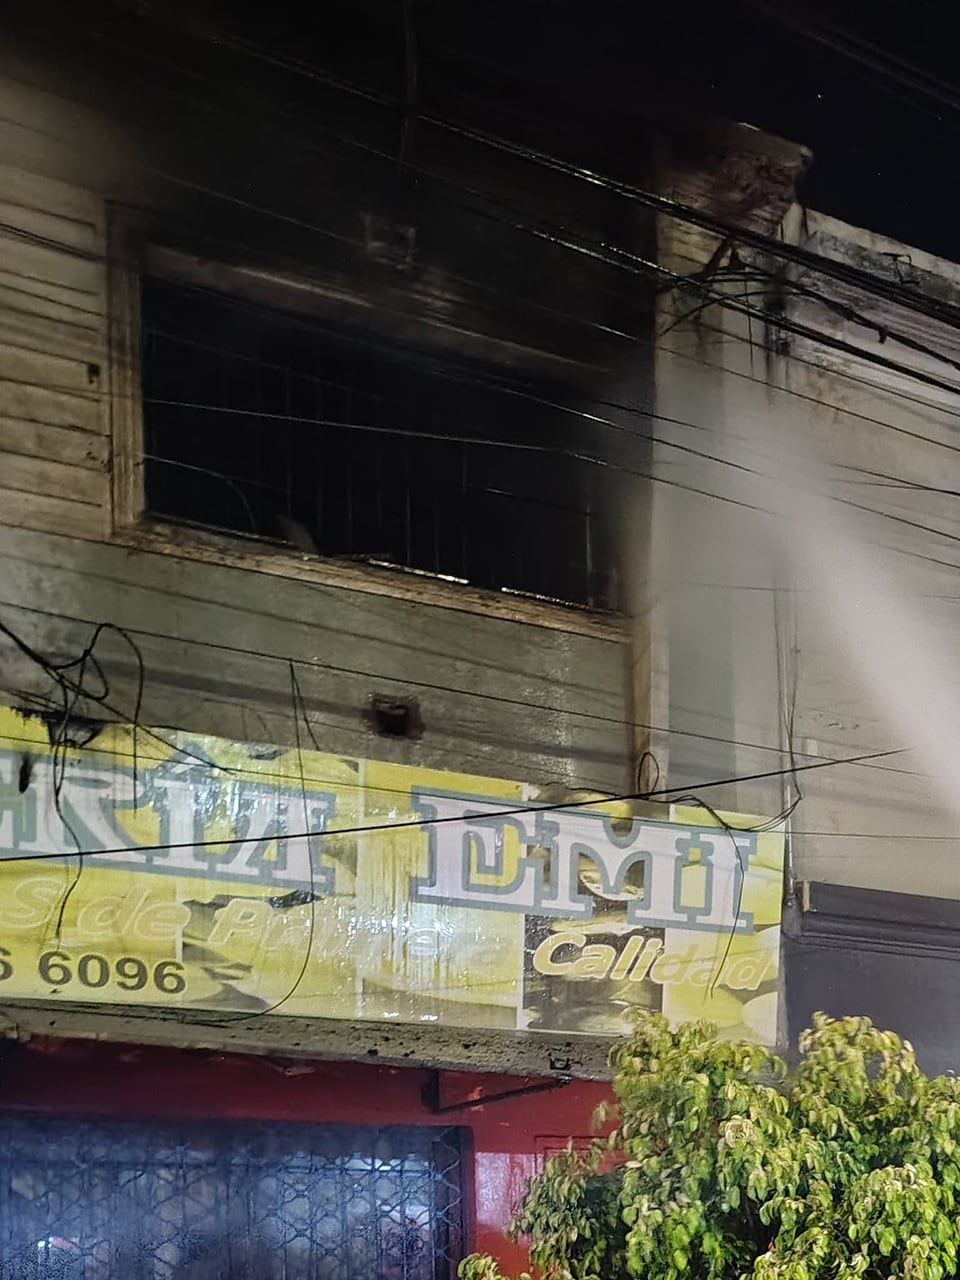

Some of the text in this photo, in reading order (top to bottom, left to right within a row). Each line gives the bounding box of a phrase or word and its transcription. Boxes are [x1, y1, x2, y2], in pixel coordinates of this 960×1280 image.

[0, 743, 336, 892] RÍA
[410, 785, 757, 934] EMI
[77, 886, 191, 940] de
[38, 949, 188, 995] 6096
[532, 930, 775, 991] Calidad
